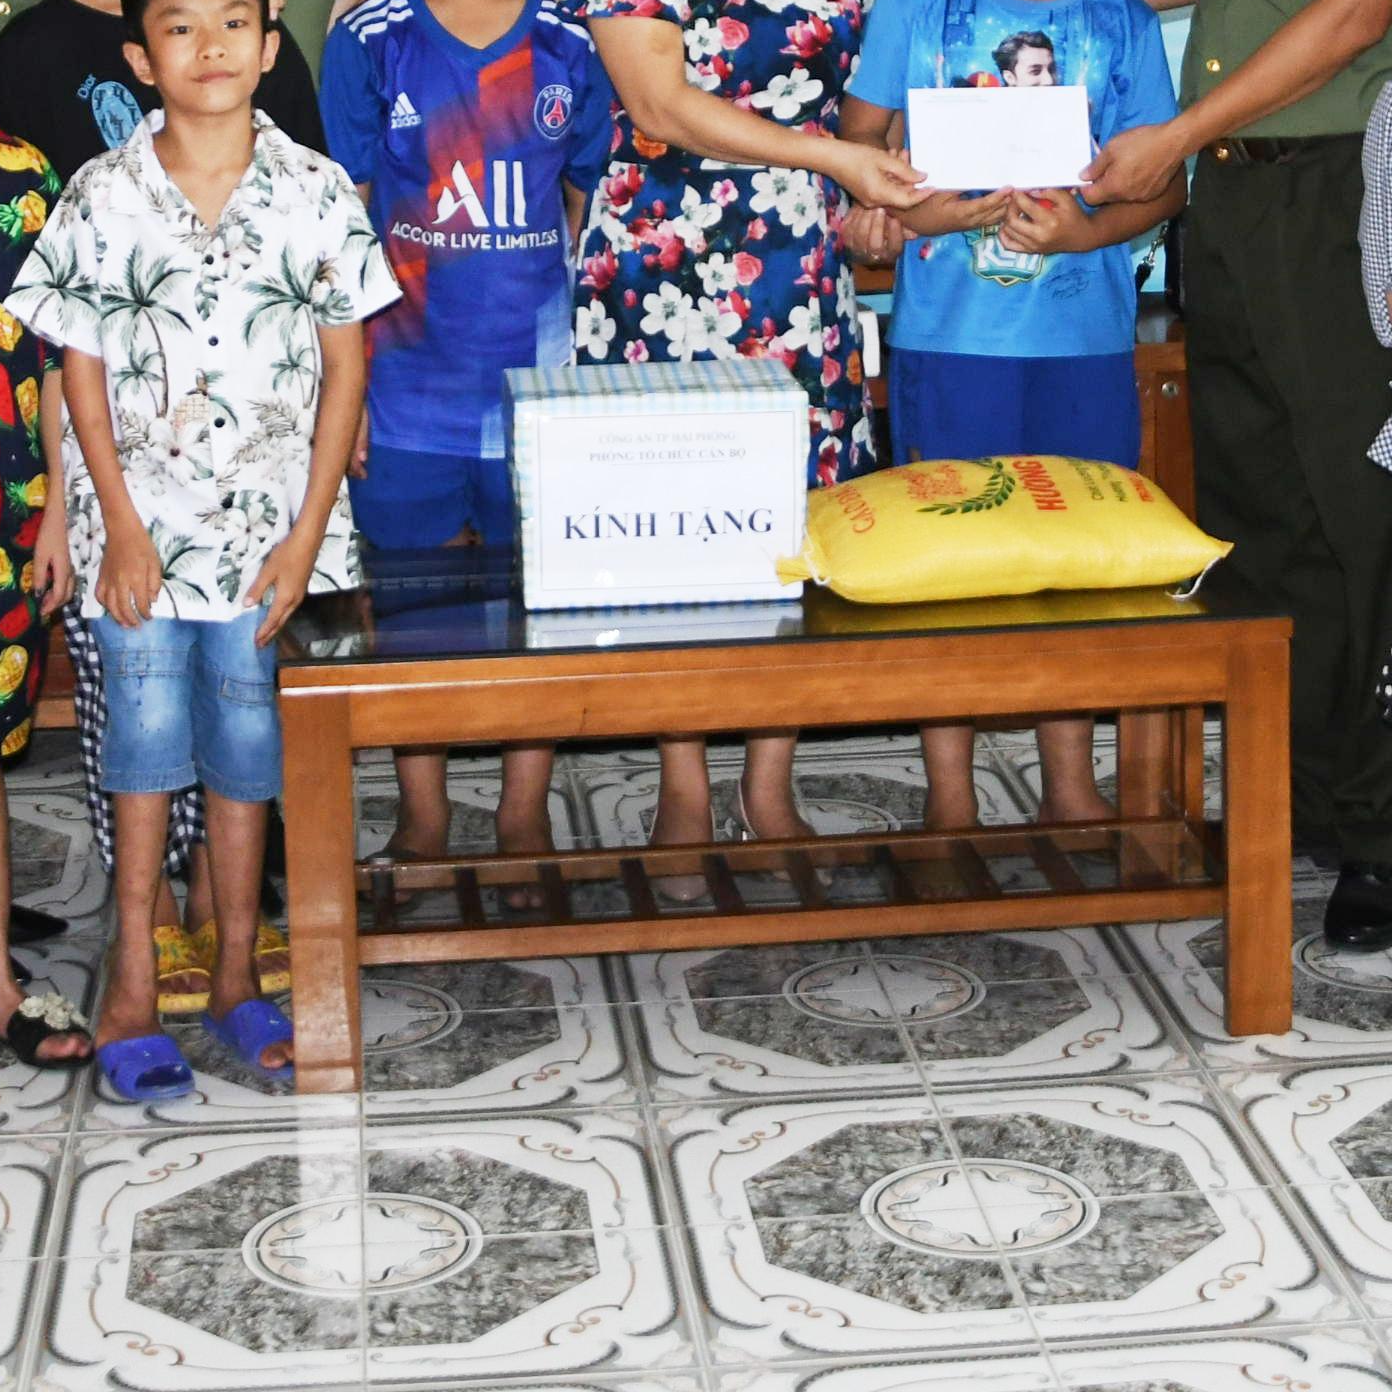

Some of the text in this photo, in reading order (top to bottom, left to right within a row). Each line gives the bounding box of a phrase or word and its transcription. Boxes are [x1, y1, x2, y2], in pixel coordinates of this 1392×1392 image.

[391, 222, 446, 248] ACCOR
[450, 233, 491, 249] LIVE
[563, 505, 657, 539] KÍNH
